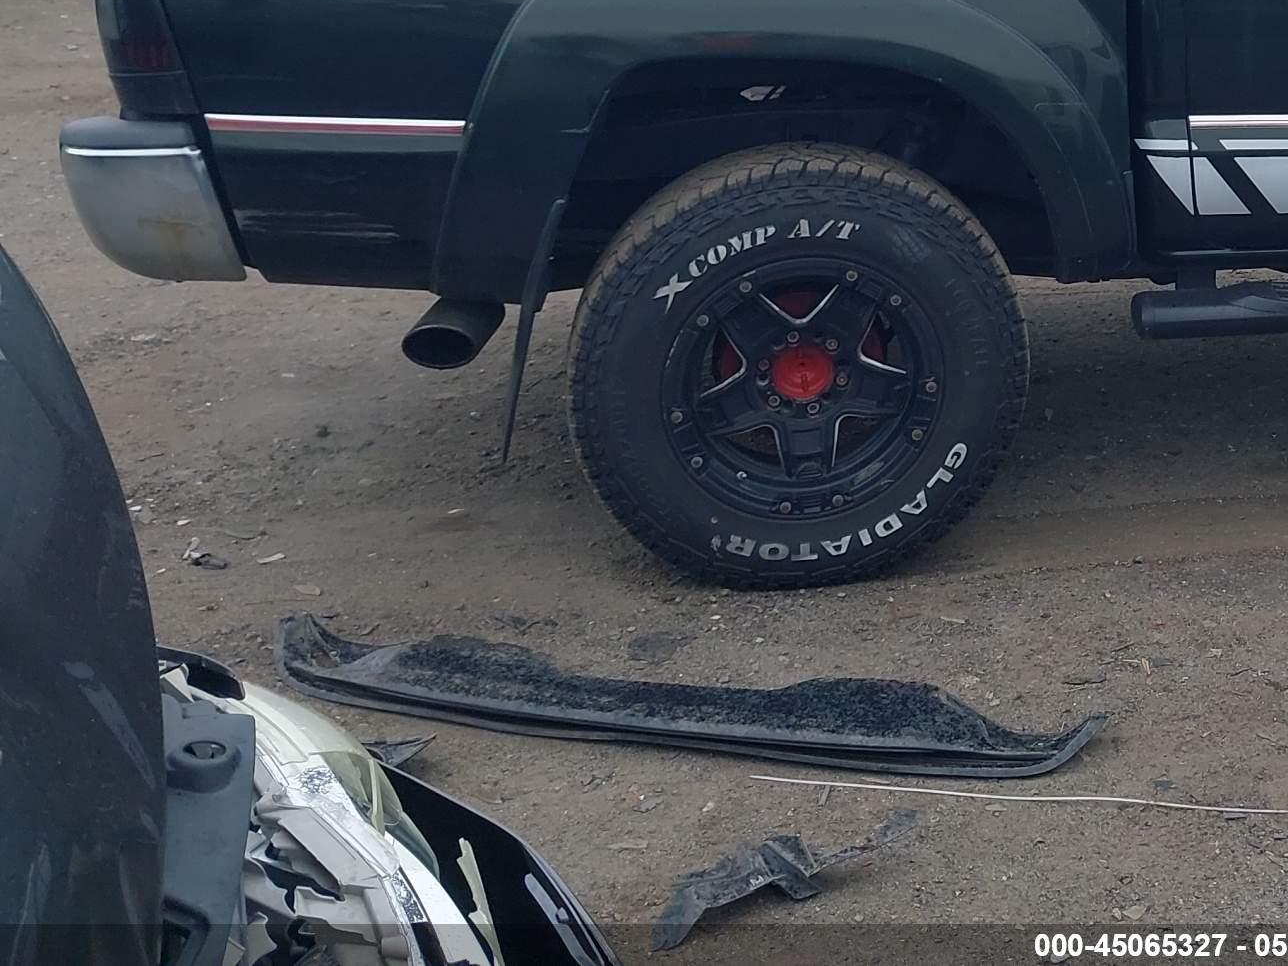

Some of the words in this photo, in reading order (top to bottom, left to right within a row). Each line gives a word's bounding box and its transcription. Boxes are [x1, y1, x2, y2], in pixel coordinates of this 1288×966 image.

[653, 273, 694, 315] X
[688, 225, 776, 278] COMP
[787, 218, 861, 240] A/T
[725, 442, 968, 561] GLADIATOR
